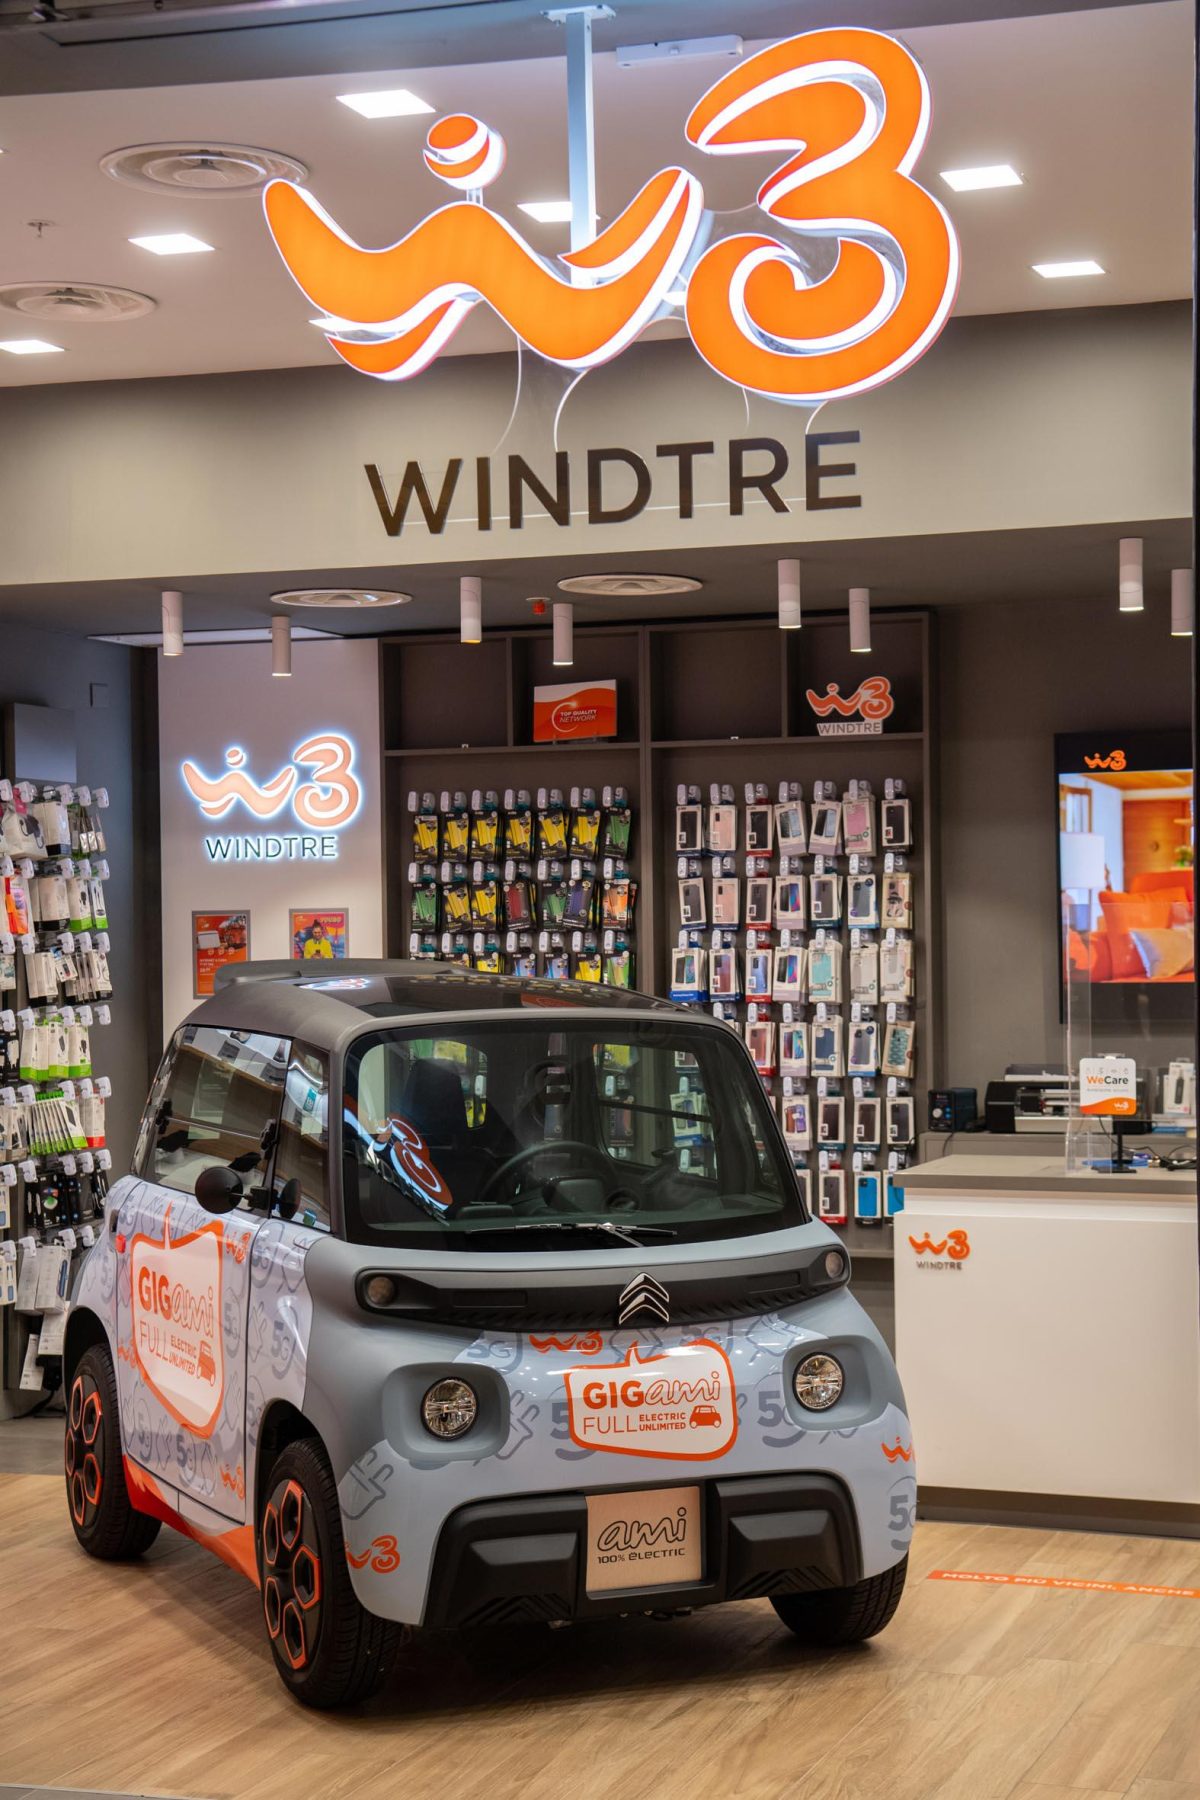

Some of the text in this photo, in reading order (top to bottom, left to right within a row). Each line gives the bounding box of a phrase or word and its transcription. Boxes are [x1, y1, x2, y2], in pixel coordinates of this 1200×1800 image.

[364, 430, 862, 537] WINDTRE
[560, 715, 596, 723] NETWORK
[819, 722, 881, 734] WINDTRE
[205, 836, 337, 859] WINDTRE
[1086, 1075, 1129, 1085] WeCare
[916, 1261, 962, 1270] WINDTRE
[139, 1320, 169, 1362] FULL
[171, 1334, 197, 1359] ELECTRIC
[168, 1352, 196, 1375] UNLIMITED
[583, 1414, 637, 1435] FULL
[639, 1412, 686, 1422] ELECTRIC
[639, 1421, 686, 1432] UNLIMITED
[597, 1507, 687, 1552] ami
[597, 1554, 626, 1565] 100%
[942, 1572, 1009, 1581] MOLTO
[1053, 1579, 1117, 1591] VICINI,
[1123, 1585, 1196, 1597] ANCHE
